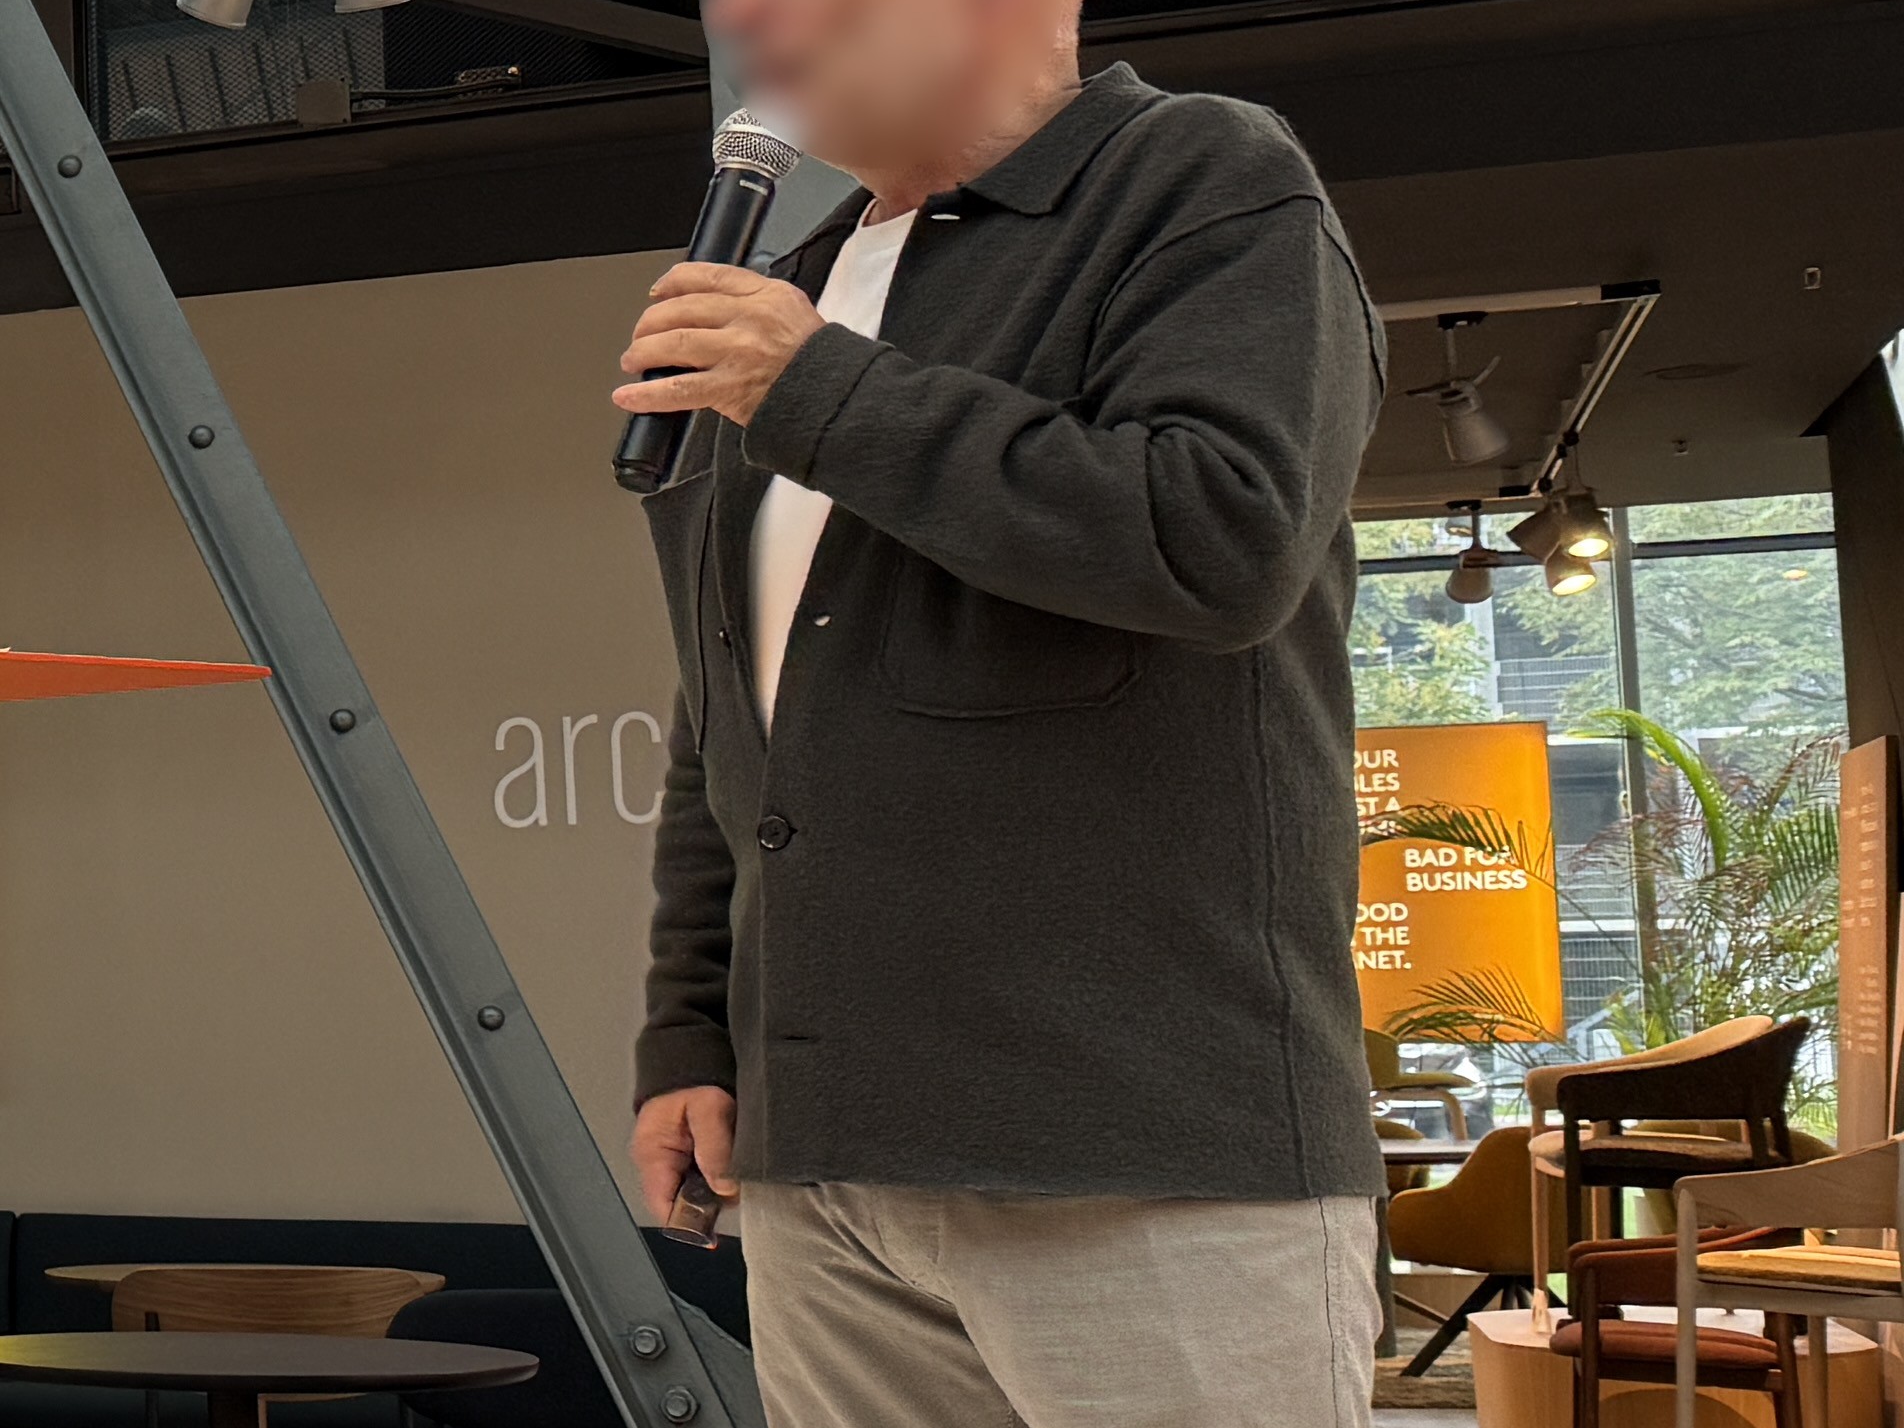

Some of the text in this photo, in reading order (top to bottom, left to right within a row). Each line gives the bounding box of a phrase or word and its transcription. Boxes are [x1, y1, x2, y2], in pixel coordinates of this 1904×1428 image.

[494, 710, 667, 828] arc
[1354, 772, 1401, 794] LES
[1404, 847, 1459, 868] BAD
[1405, 869, 1528, 892] BUSINESS
[1358, 926, 1411, 946] THE
